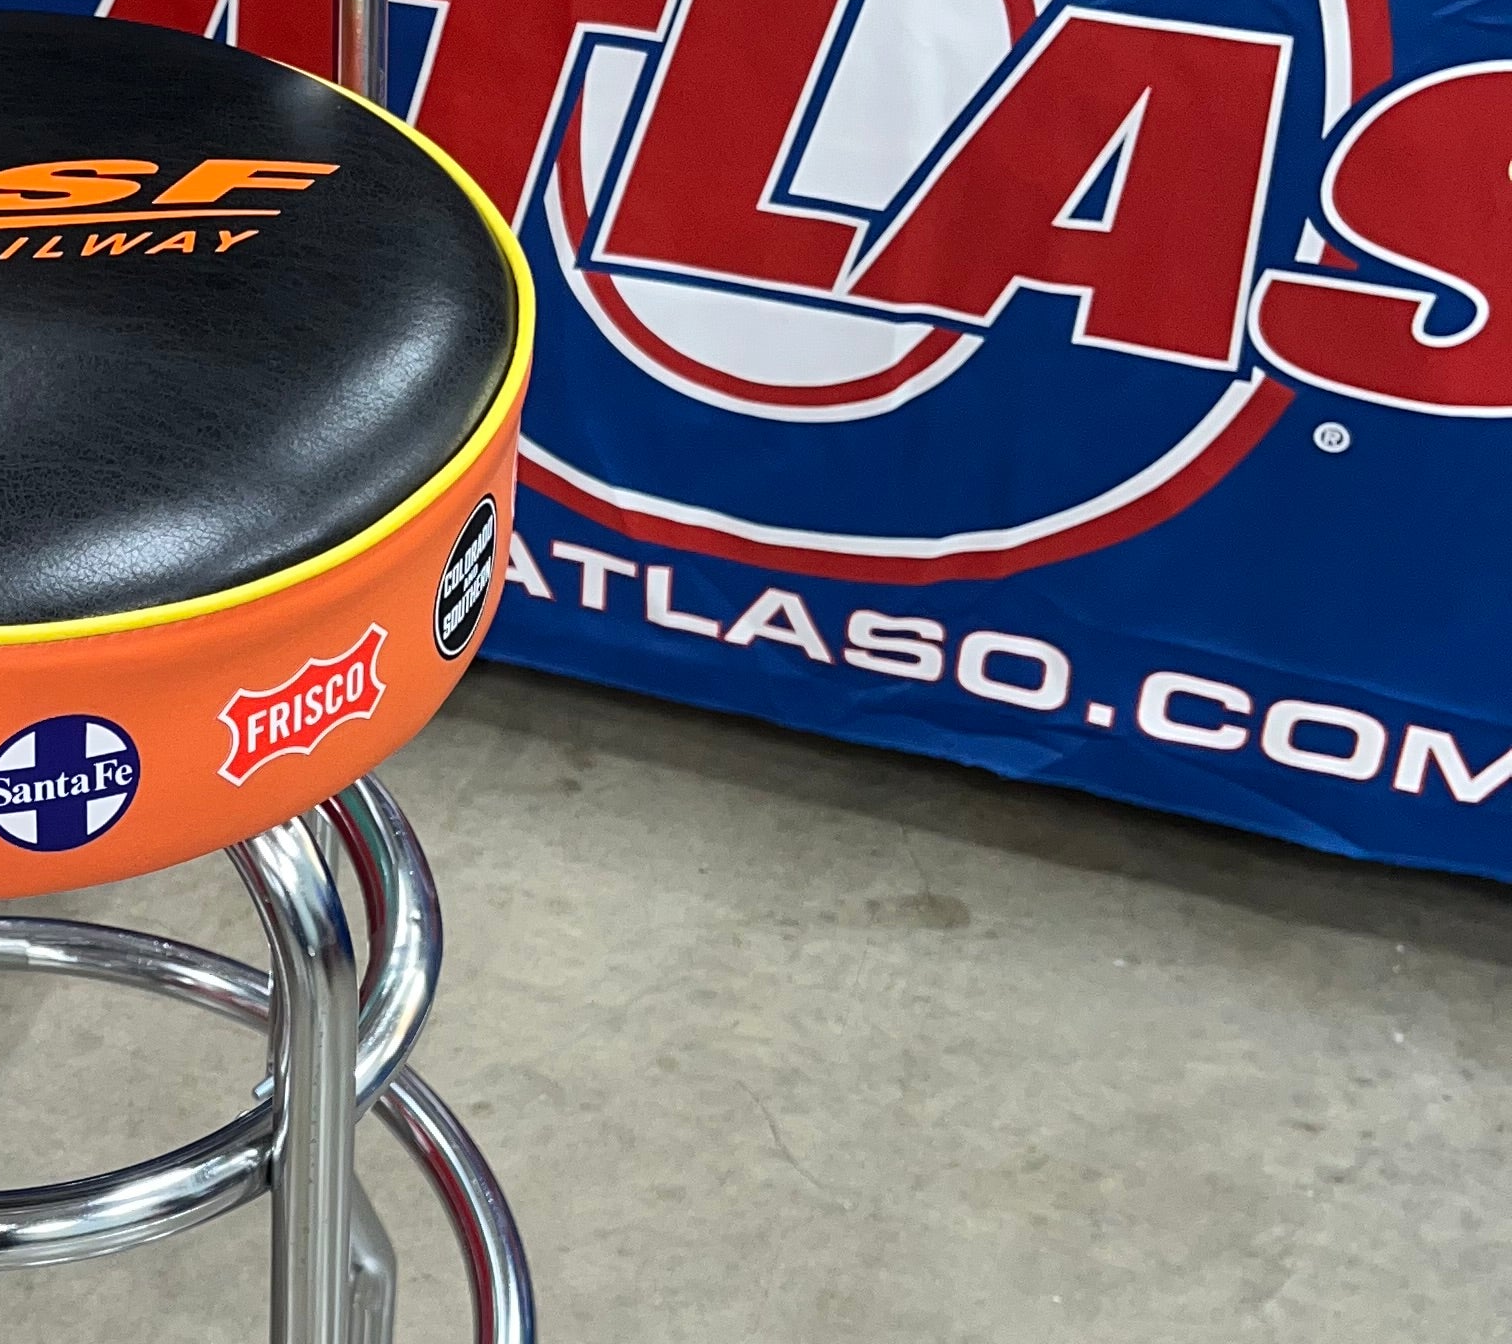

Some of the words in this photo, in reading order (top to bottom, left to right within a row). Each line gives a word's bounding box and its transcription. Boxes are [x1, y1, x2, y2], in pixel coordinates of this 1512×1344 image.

[443, 514, 494, 599] COLORADO
[443, 556, 492, 641] SOUTHERN
[463, 563, 479, 592] AND
[245, 661, 365, 753] FRISCO
